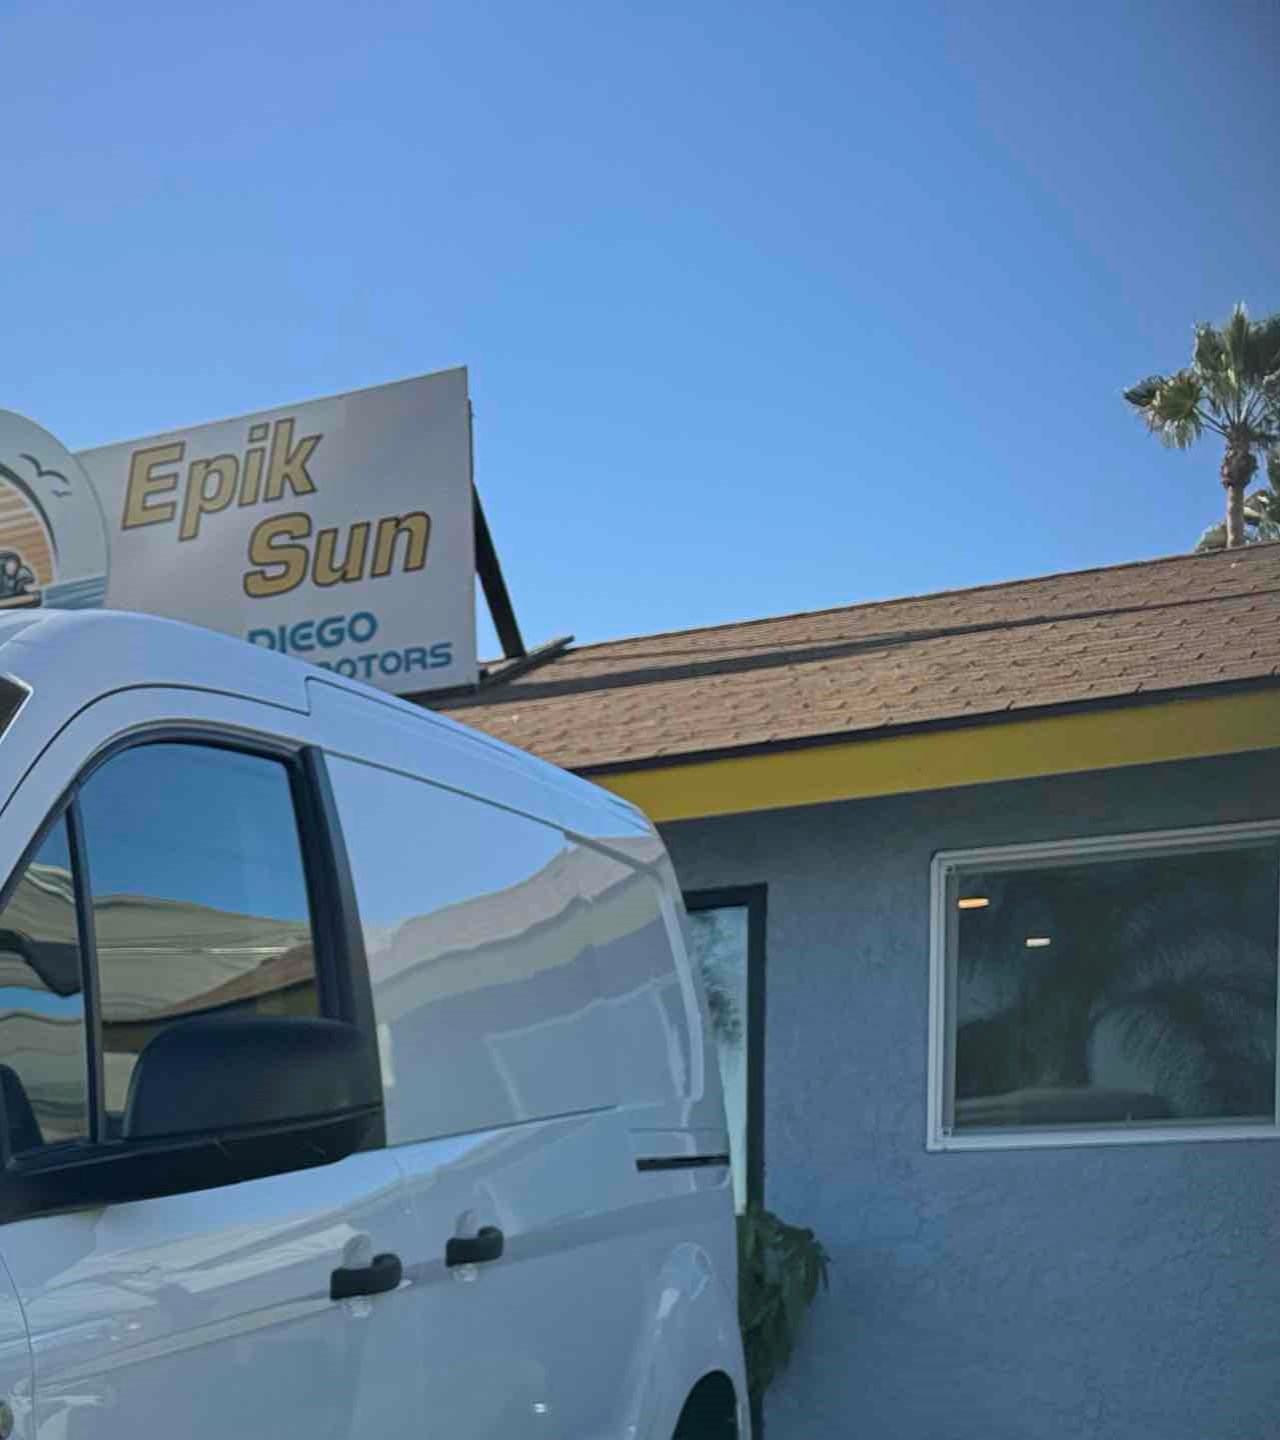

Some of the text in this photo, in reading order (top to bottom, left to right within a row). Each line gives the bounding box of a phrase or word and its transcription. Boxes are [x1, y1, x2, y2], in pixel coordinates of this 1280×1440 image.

[121, 417, 324, 542] Epik
[243, 511, 431, 599] Sun
[248, 611, 378, 653] DIEGO
